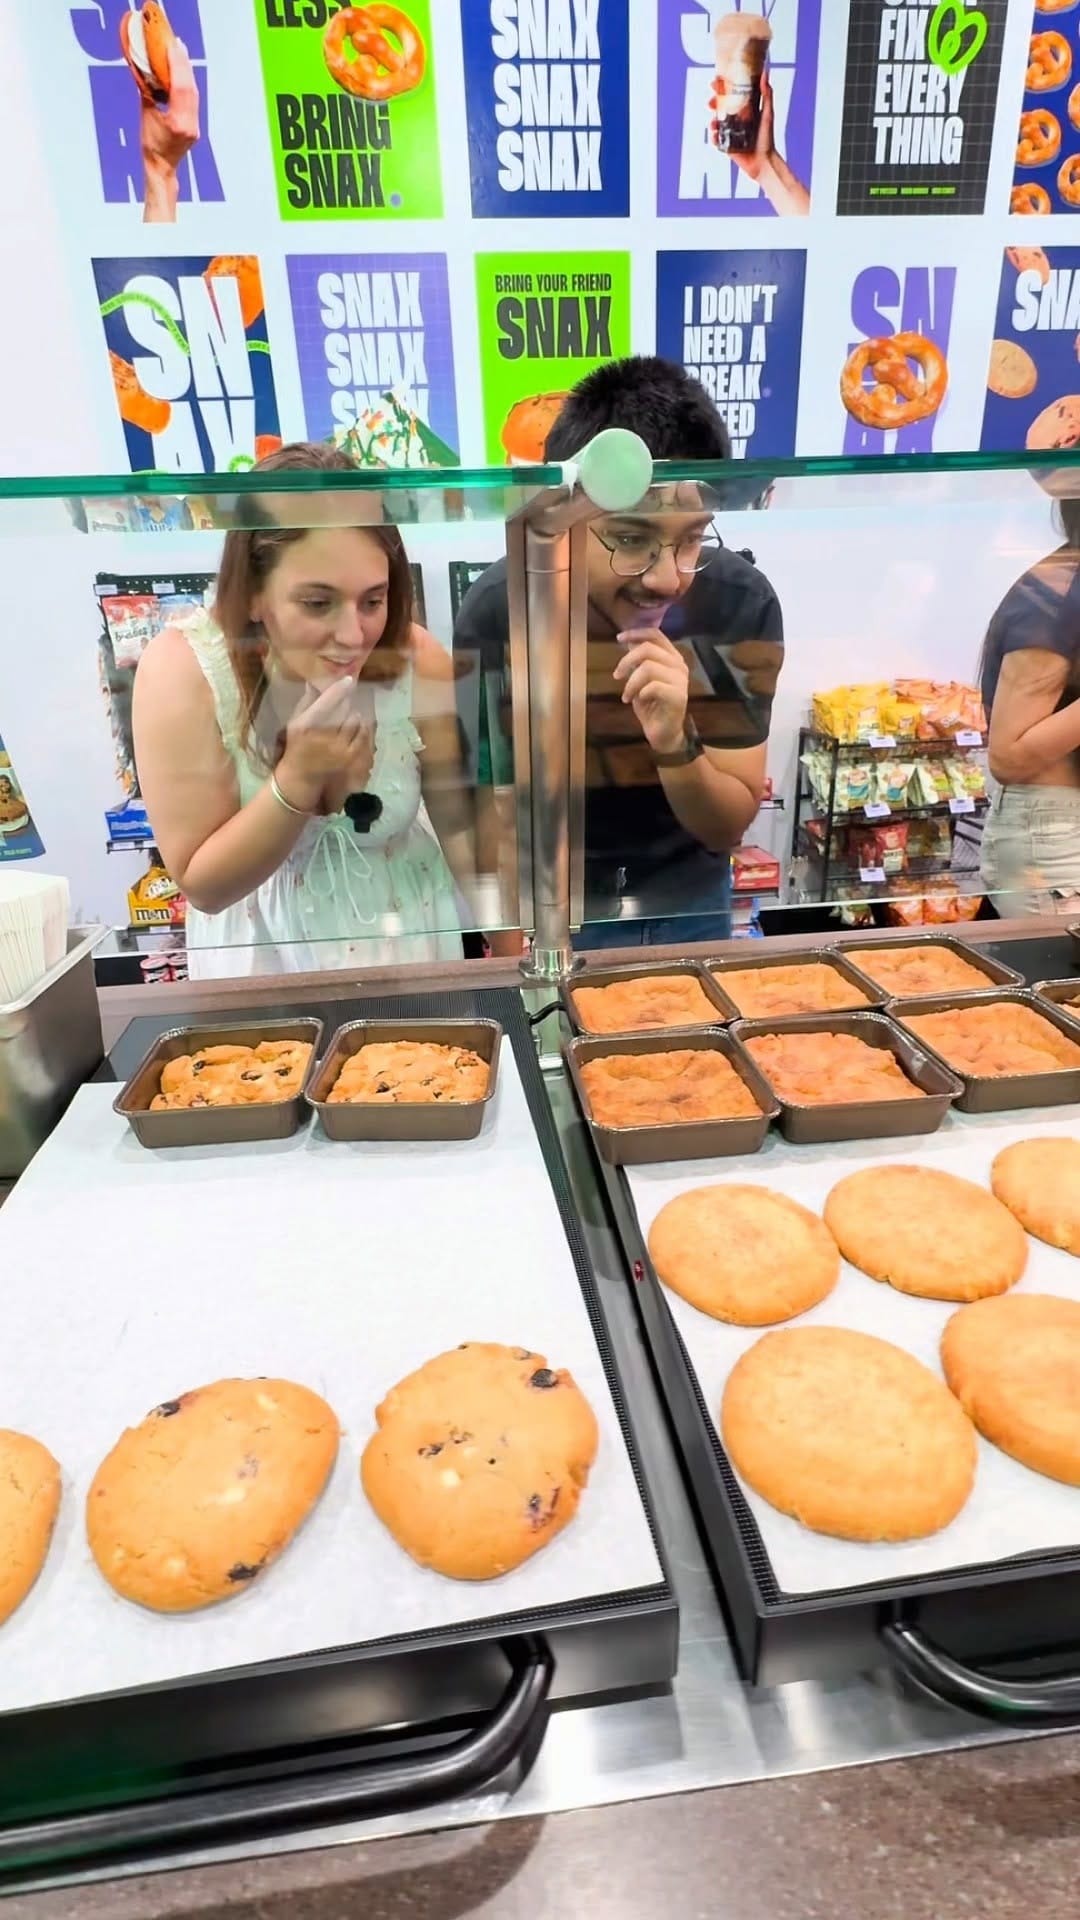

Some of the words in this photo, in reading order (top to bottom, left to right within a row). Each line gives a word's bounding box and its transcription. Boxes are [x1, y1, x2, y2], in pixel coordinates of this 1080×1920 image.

[490, 0, 601, 59] SNAX
[879, 9, 930, 60] FIX
[493, 63, 602, 127] SNAX
[874, 64, 968, 113] EVERY
[276, 94, 392, 150] BRING
[873, 116, 964, 165] THING
[497, 130, 603, 191] SNAX
[317, 272, 424, 329] SNAX
[495, 275, 532, 292] BRING
[536, 274, 568, 292] YOUR
[572, 274, 612, 292] FRIEND
[684, 286, 693, 324] I
[700, 285, 778, 324] DON'T
[496, 296, 612, 359] SNAX
[683, 326, 743, 363] NEED
[750, 325, 766, 362] A
[324, 332, 429, 387] SNAX
